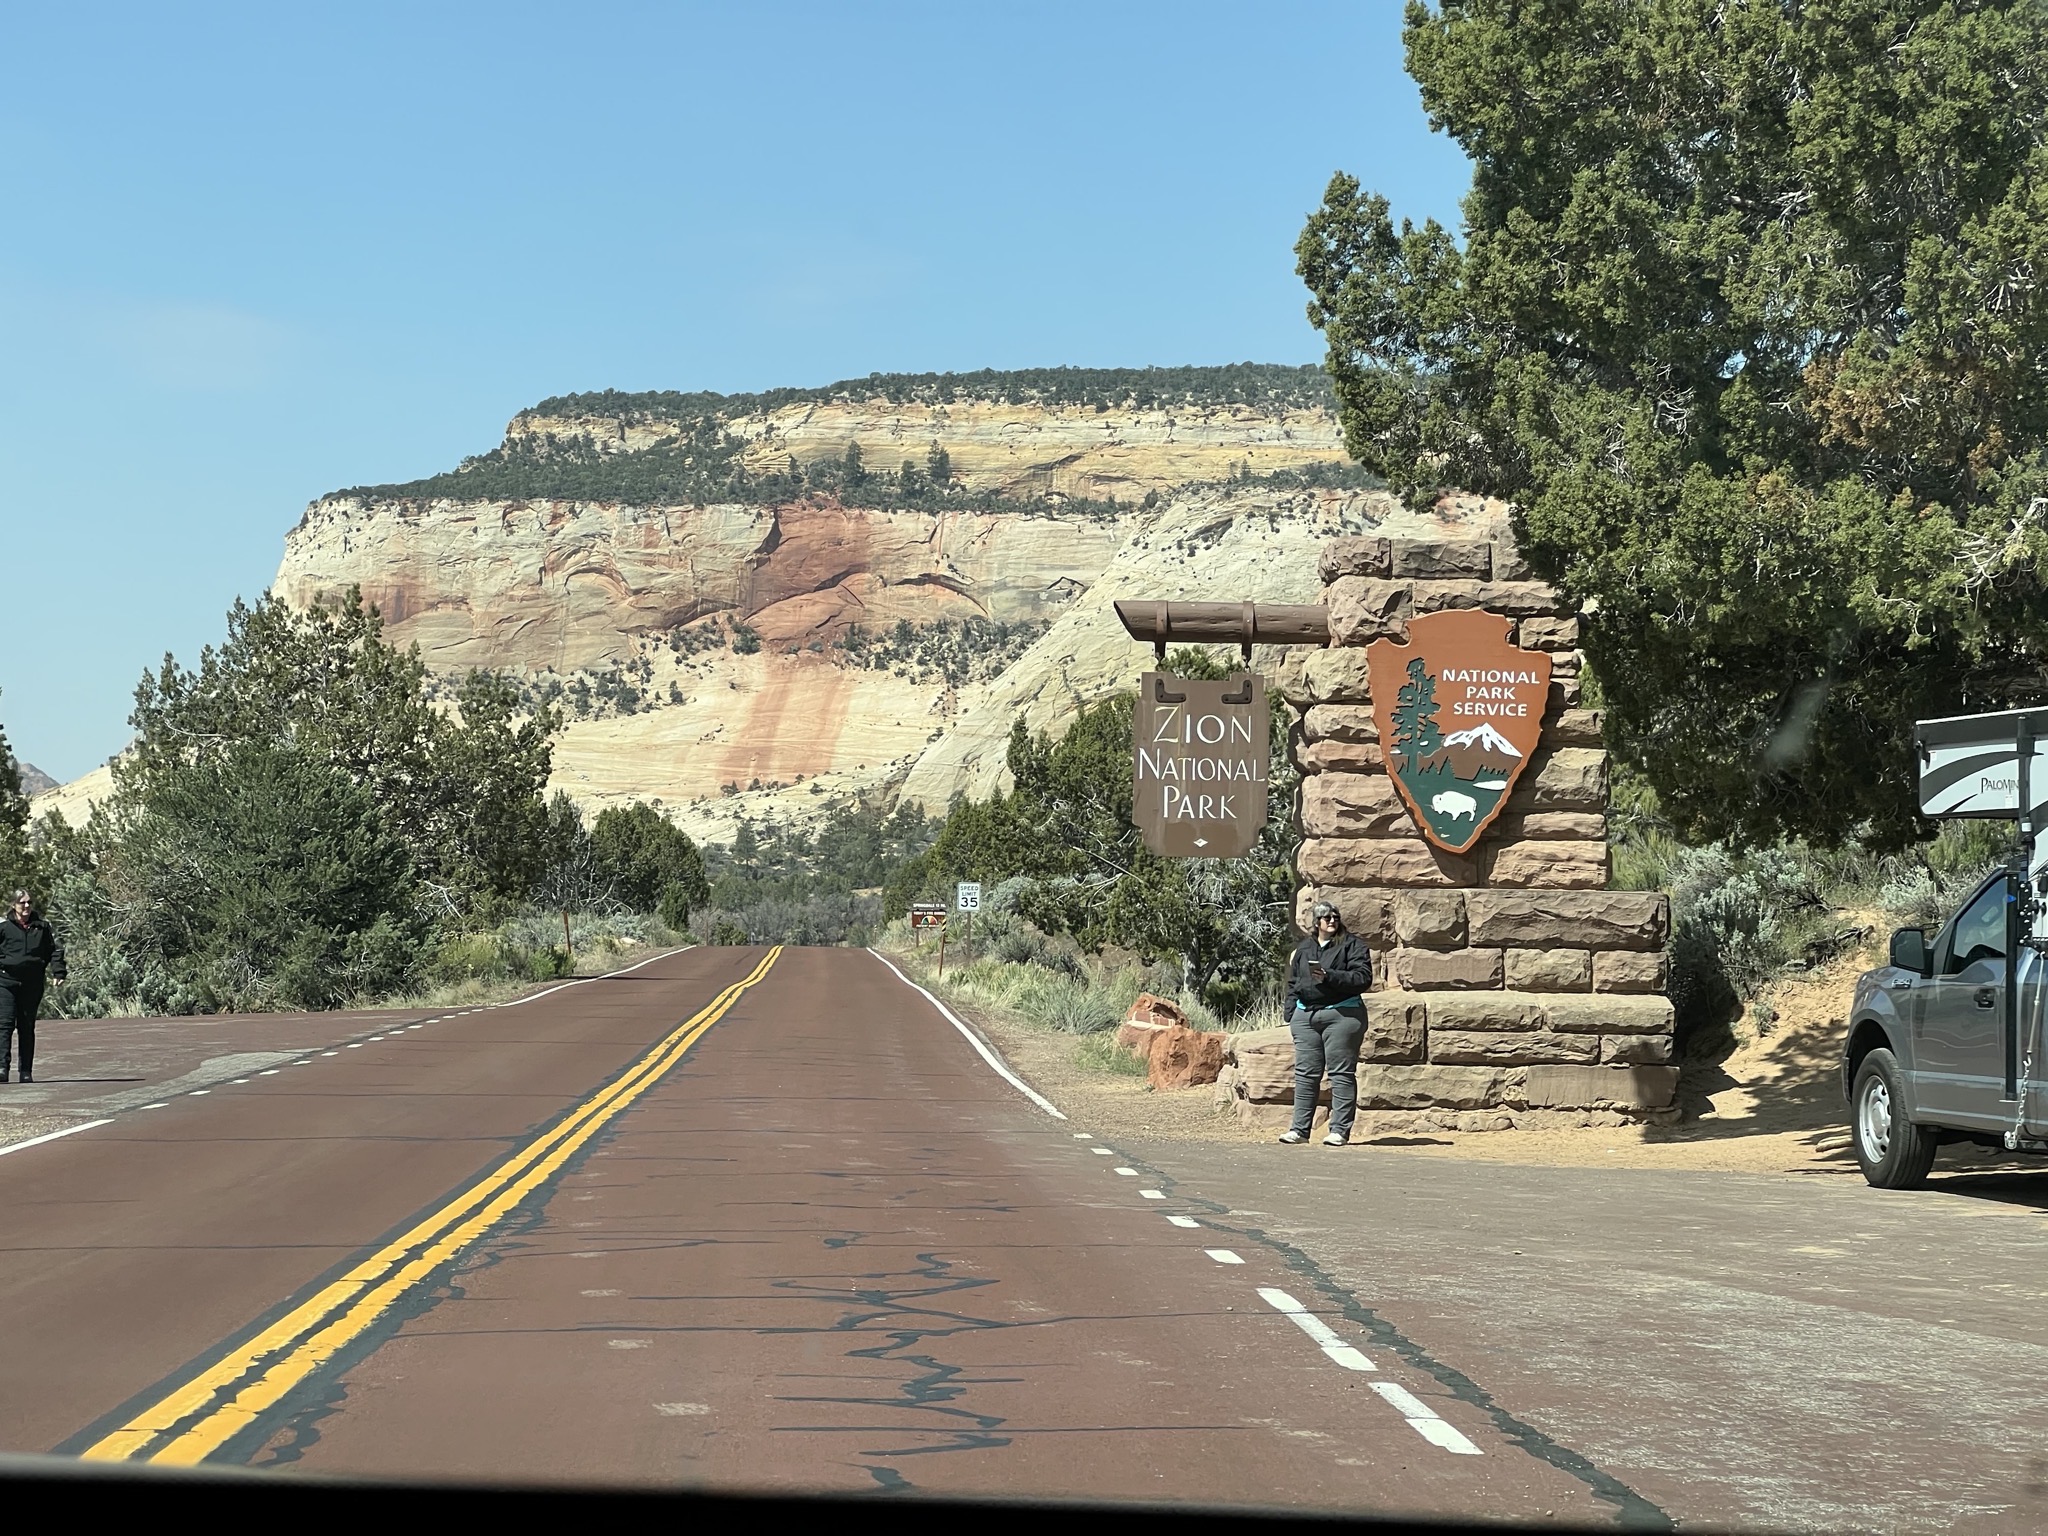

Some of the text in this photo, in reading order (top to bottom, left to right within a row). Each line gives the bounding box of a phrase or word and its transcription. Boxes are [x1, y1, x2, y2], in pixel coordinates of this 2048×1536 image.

[1442, 668, 1540, 685] NATIONAL
[1466, 686, 1516, 700] PARK
[1453, 702, 1528, 717] SERVICE
[1153, 705, 1252, 744] ZION
[1139, 747, 1266, 782] NATIONAL
[1981, 777, 2019, 794] PALOMIN
[1163, 785, 1238, 819] PARK
[960, 897, 978, 908] 35
